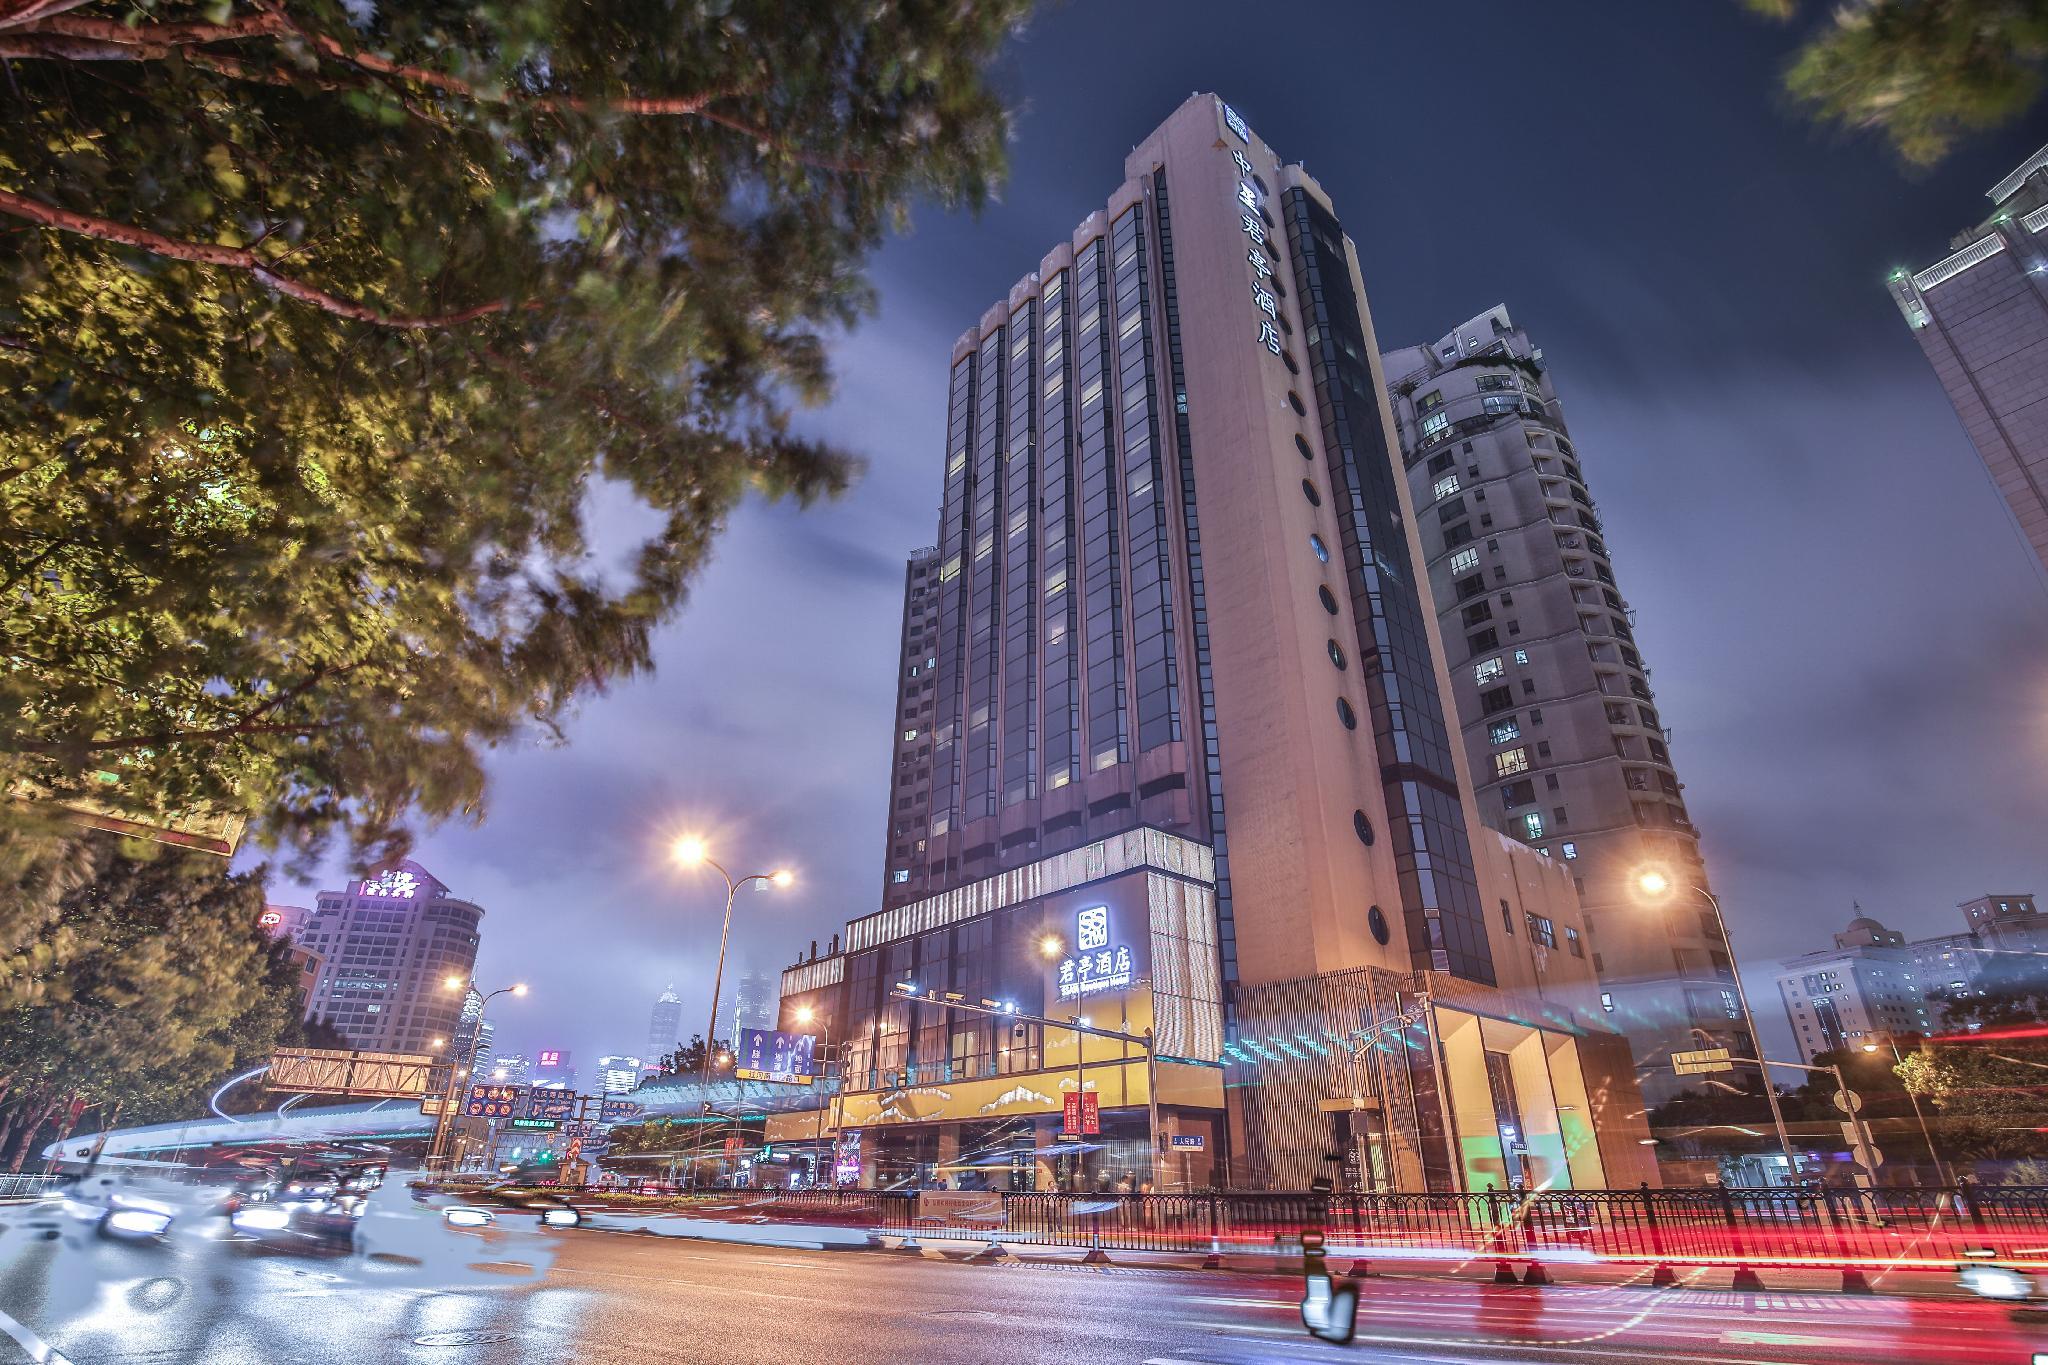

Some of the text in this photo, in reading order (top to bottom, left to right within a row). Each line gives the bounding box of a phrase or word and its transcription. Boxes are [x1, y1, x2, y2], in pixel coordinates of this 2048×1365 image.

[1231, 150, 1280, 355] 中星君亭酒店
[1059, 946, 1131, 983] 君亭酒店
